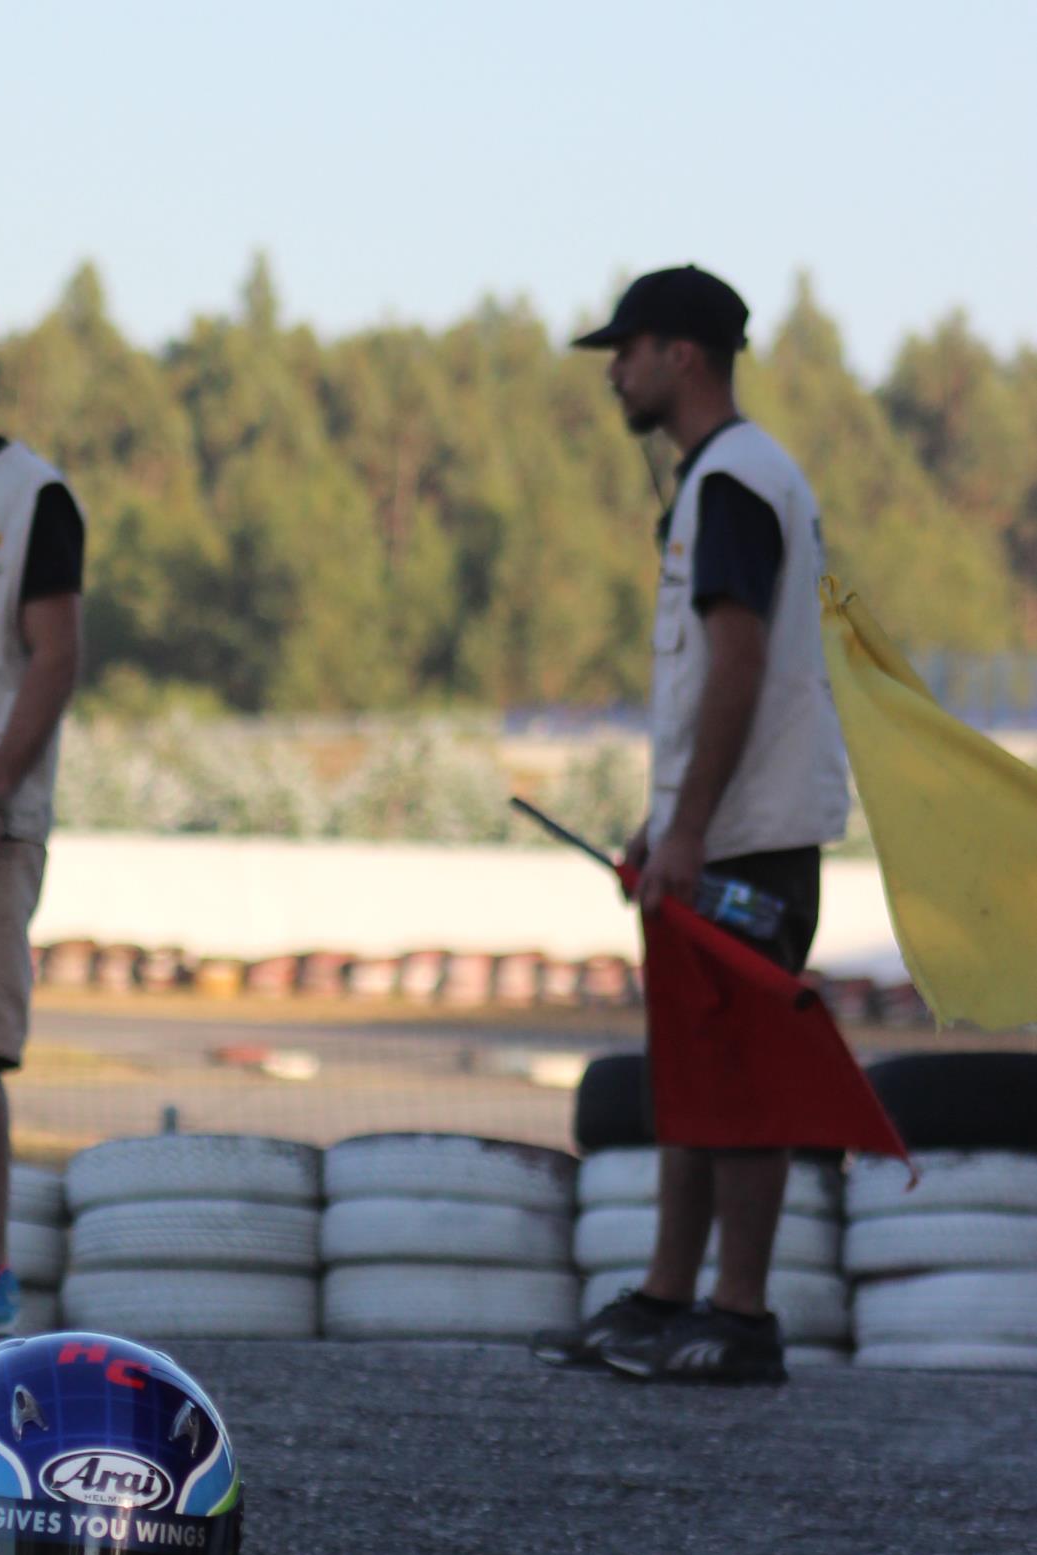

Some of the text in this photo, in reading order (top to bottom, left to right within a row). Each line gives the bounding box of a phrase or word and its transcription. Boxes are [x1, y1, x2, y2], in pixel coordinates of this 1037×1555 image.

[50, 1457, 158, 1498] Arai
[71, 1514, 128, 1541] YOU
[136, 1520, 206, 1548] WINGS
